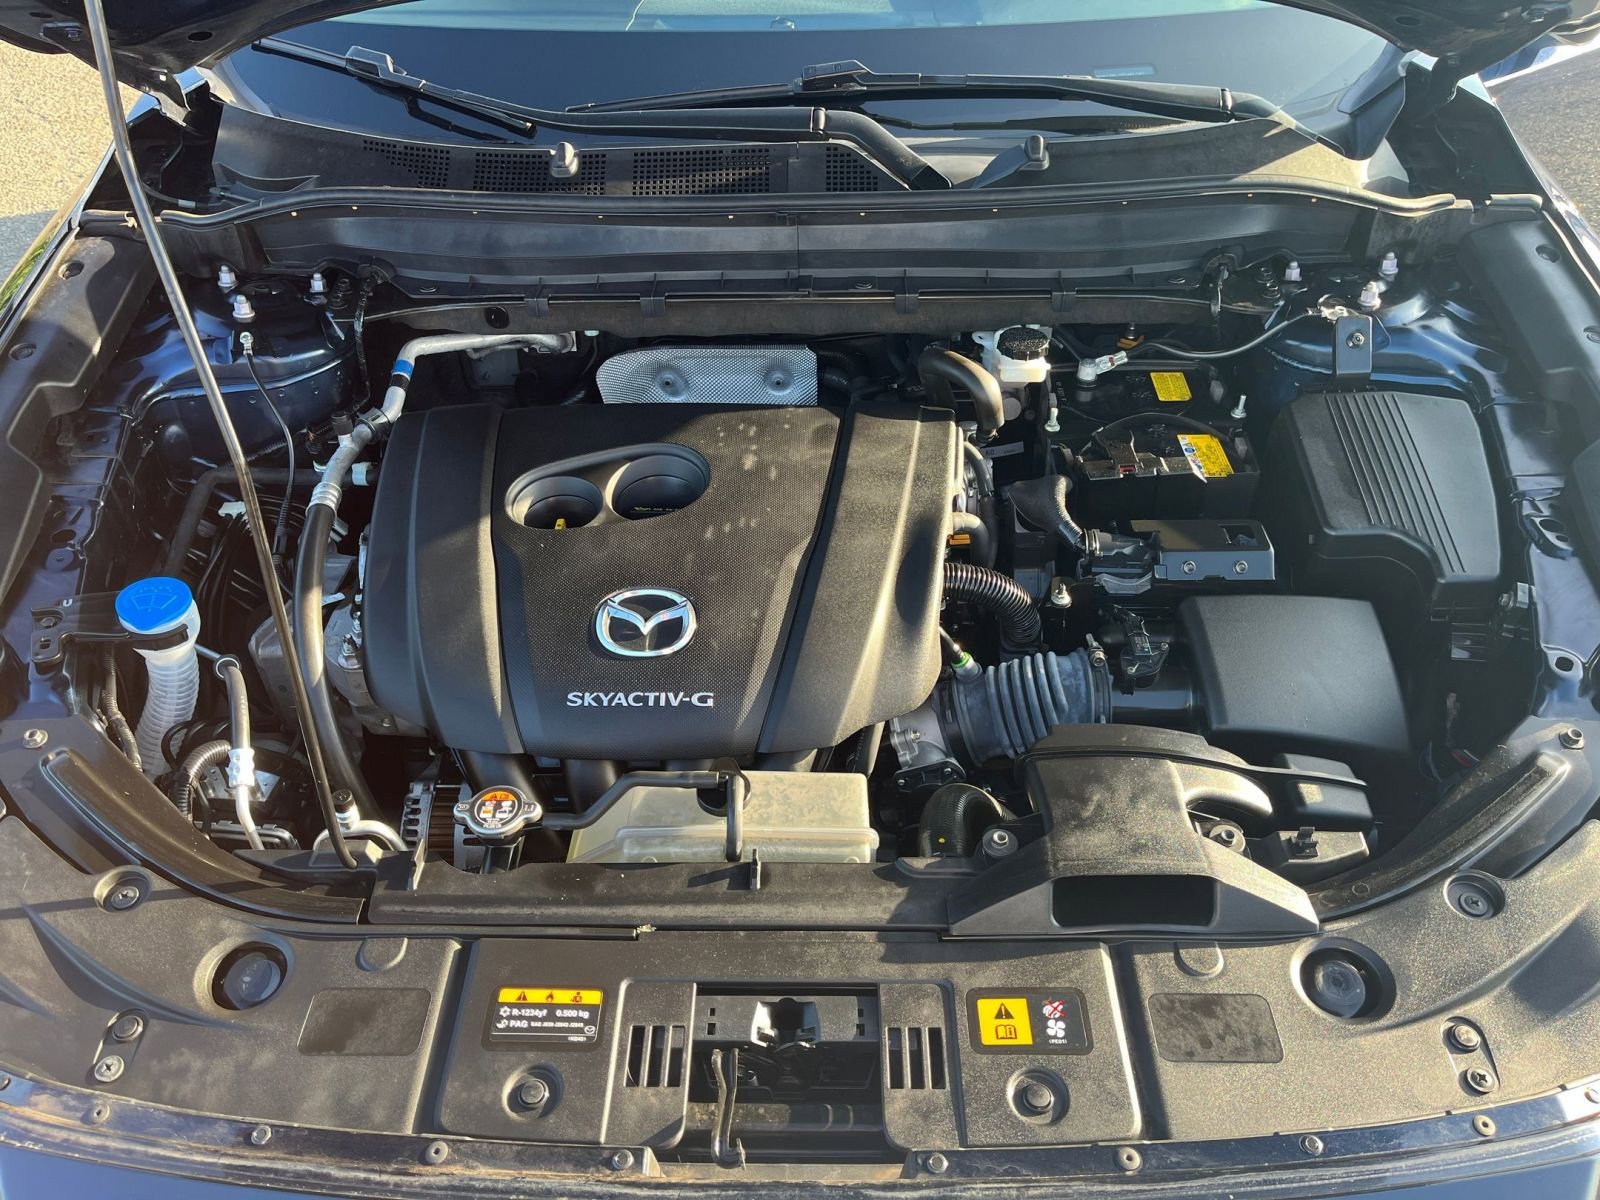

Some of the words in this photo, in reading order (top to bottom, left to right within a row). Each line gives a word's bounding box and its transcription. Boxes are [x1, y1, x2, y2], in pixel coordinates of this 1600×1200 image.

[566, 691, 714, 708] SKYACTIV-G
[511, 1008, 548, 1018] R-1234yf
[555, 1009, 578, 1018] 0.500
[578, 1009, 590, 1019] kg
[509, 1020, 529, 1028] PAG
